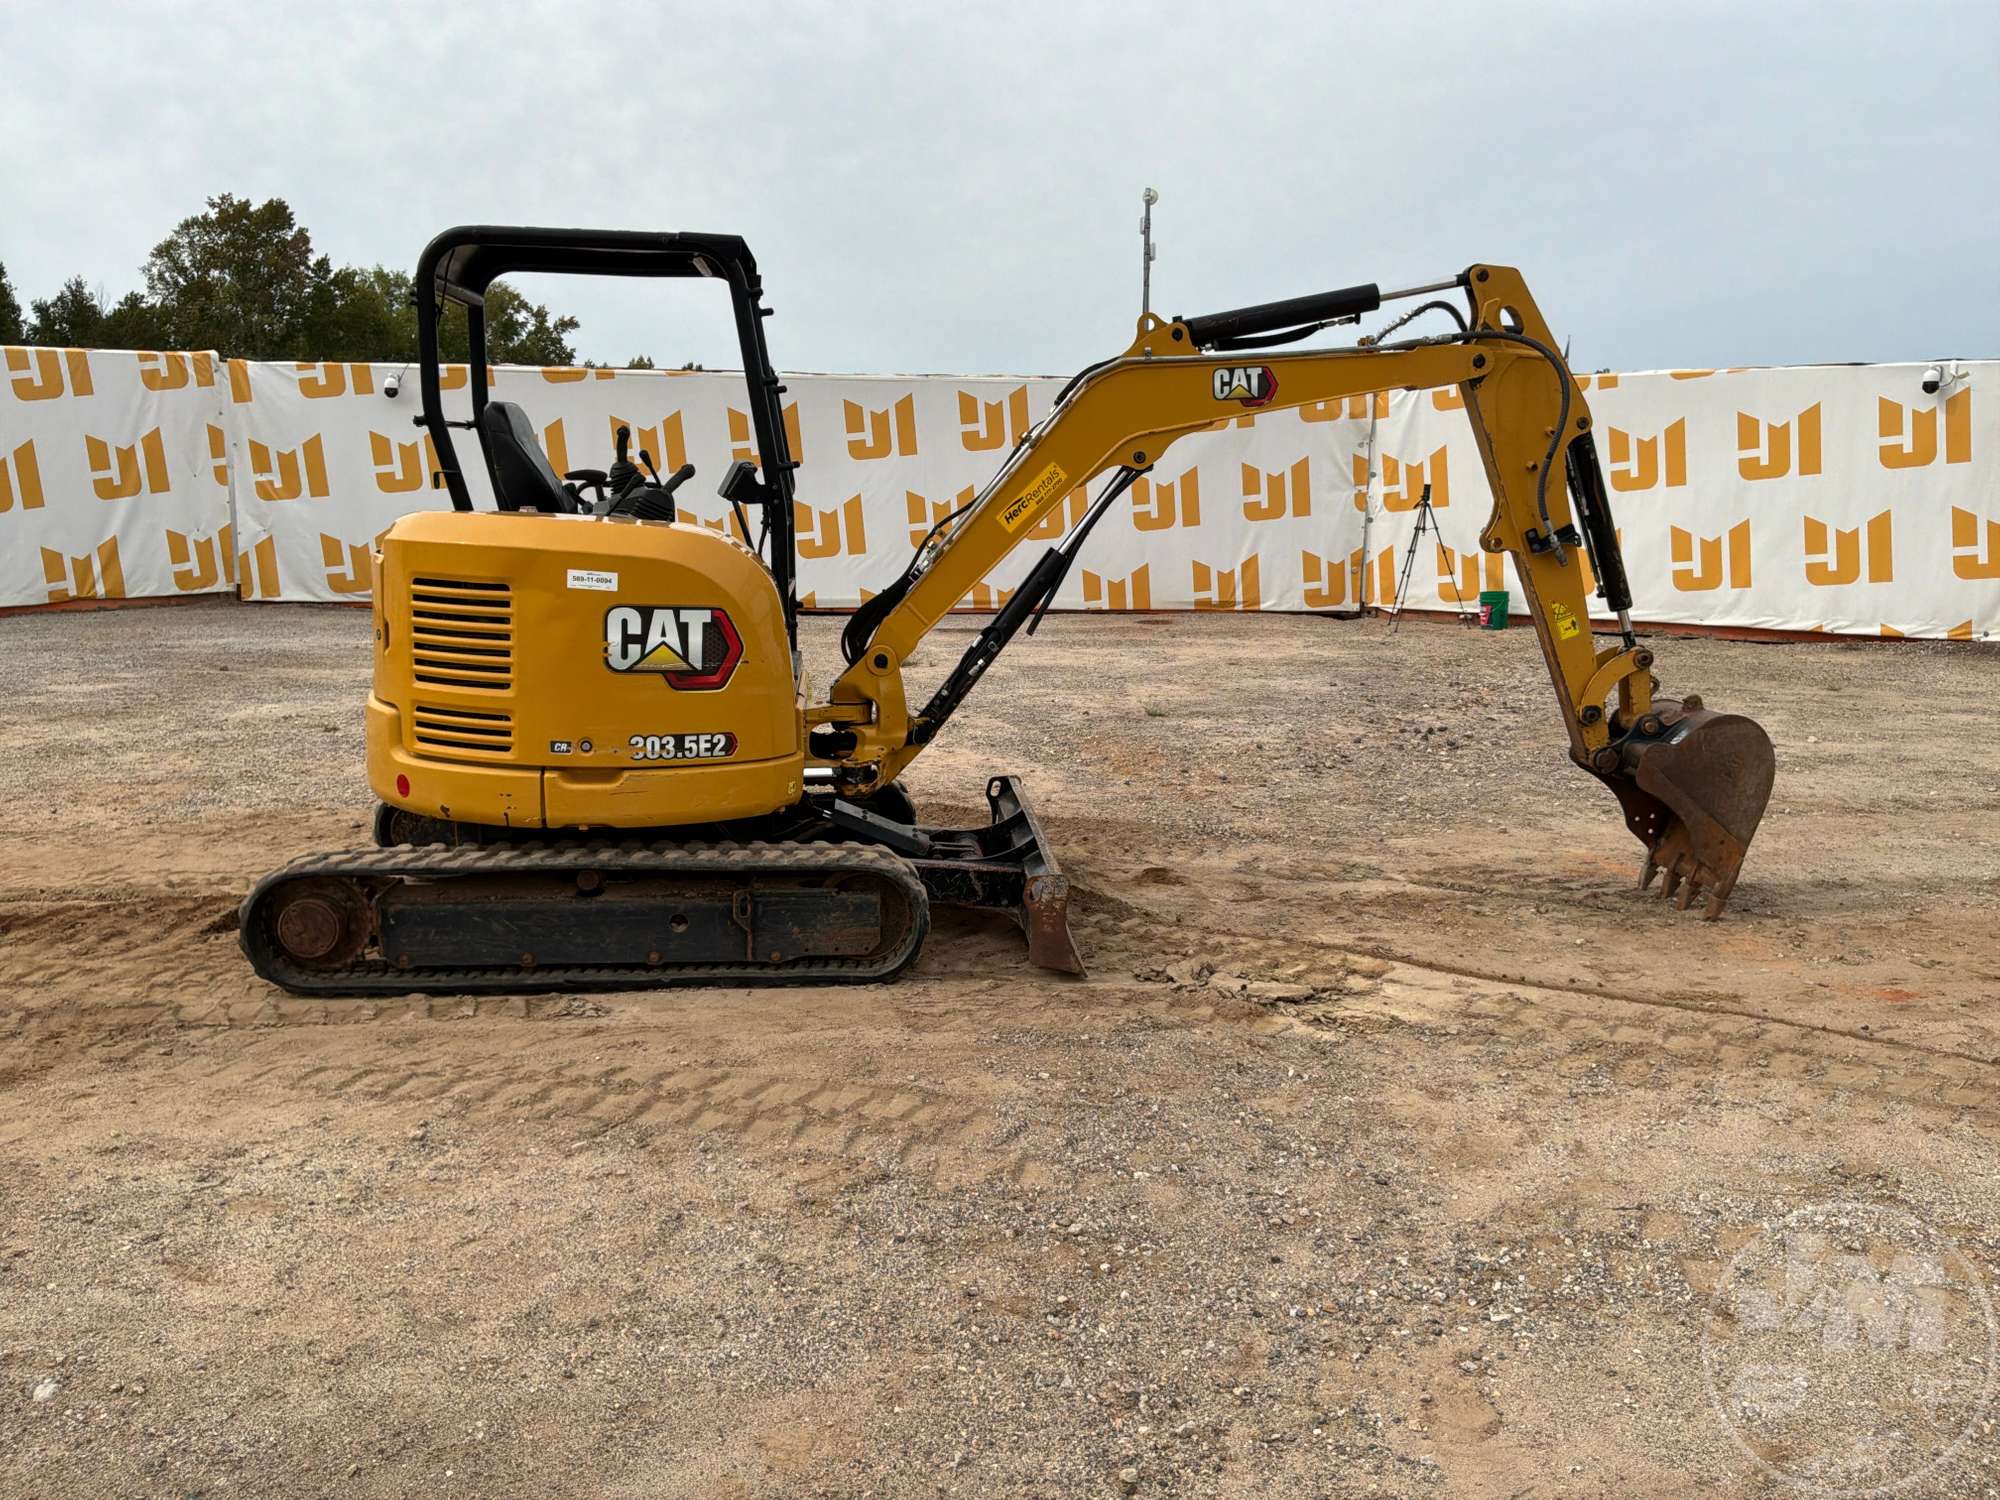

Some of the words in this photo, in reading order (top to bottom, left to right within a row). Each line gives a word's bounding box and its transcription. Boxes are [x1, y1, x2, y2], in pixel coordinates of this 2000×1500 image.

[1214, 367, 1262, 400] CAT
[607, 607, 711, 670] CAT
[630, 733, 726, 759] 303.5E2
